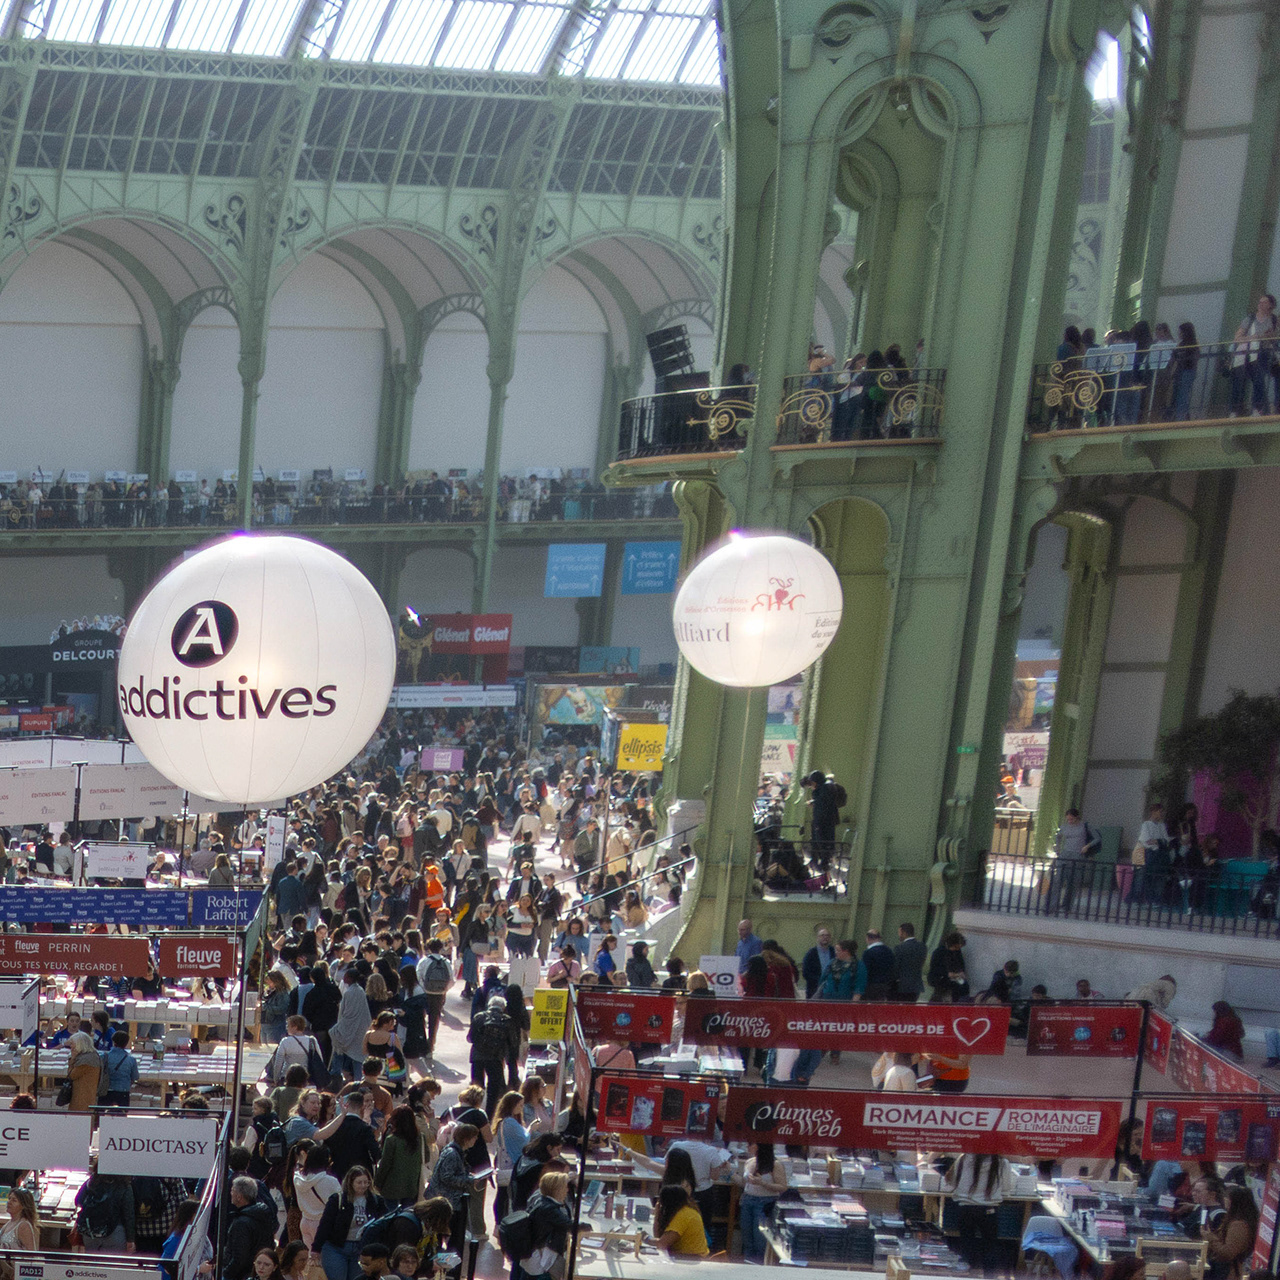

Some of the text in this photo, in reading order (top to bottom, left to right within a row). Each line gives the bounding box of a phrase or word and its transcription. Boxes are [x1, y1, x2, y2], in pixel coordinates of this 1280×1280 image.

[434, 627, 470, 642] Glénat
[474, 626, 509, 642] Glénat
[74, 639, 103, 647] GROUPE
[119, 675, 338, 721] addictives
[207, 895, 249, 908] Robert
[204, 908, 248, 921] Laffont
[15, 939, 40, 952] fleuve
[48, 942, 91, 953] PERRIN
[176, 944, 222, 964] fleuve
[23, 960, 41, 969] TES
[43, 961, 71, 972] YEUX,
[74, 962, 118, 972] REGARDE
[705, 972, 734, 986] XO
[540, 1017, 562, 1026] OFFERT
[787, 1018, 945, 1035] CRÉATEUR DE COUPS DE
[724, 1023, 771, 1039] du Web
[868, 1107, 990, 1127] ROMANCE
[1008, 1112, 1097, 1126] ROMANCE
[777, 1117, 842, 1137] du Web
[1006, 1123, 1096, 1133] DE L'IMAGINAIRE
[105, 1136, 209, 1156] ADDICTASY
[20, 1267, 108, 1278] PAD12 addictives
